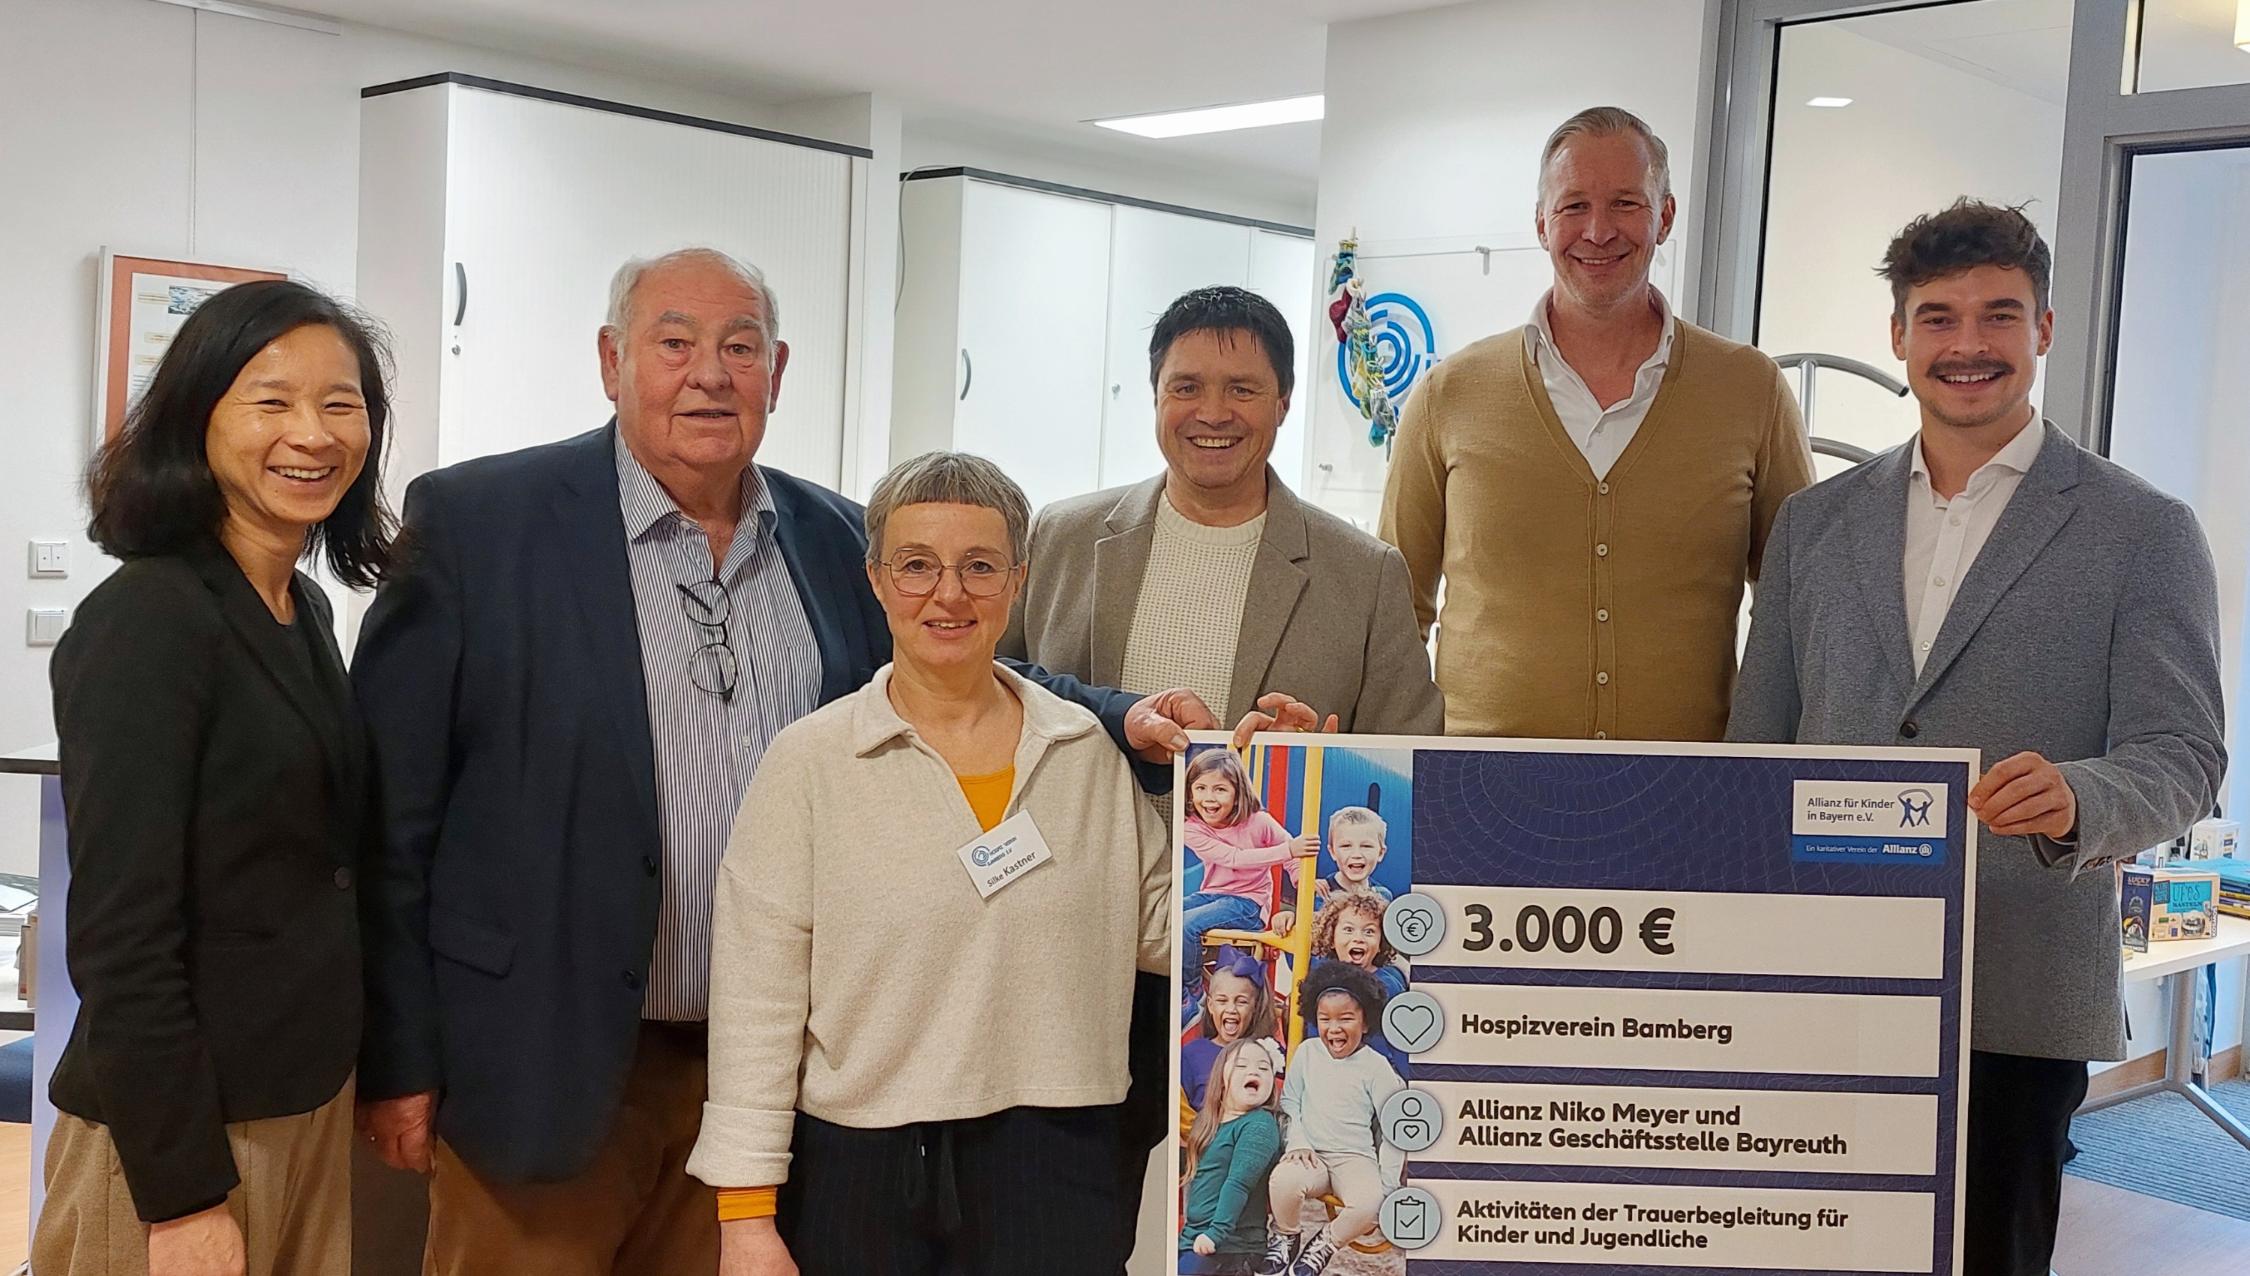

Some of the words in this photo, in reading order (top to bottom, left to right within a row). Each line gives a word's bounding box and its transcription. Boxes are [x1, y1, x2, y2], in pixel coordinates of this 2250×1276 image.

[1807, 798, 1842, 808] Allianz
[1844, 798, 1858, 808] für
[1861, 799, 1895, 809] Kinder
[1807, 811, 1817, 820] in
[1819, 811, 1854, 823] Bayern
[1856, 812, 1874, 822] e.V.
[1806, 844, 1816, 852] Ein
[1847, 845, 1867, 853] Verein
[1867, 845, 1878, 853] der
[1882, 844, 1918, 854] Allianz
[987, 874, 1004, 887] Silke
[1003, 852, 1036, 876] Kastner
[1463, 904, 1622, 954] 3.000
[1639, 908, 1675, 955] €
[1462, 1014, 1614, 1039] Hospizverein
[1623, 1018, 1732, 1044] Bamberg
[1459, 1099, 1542, 1121] Allianz
[1550, 1101, 1605, 1122] Niko
[1613, 1103, 1689, 1128] Meyer
[1696, 1105, 1740, 1125] und
[1459, 1126, 1542, 1147] Allianz
[1549, 1128, 1729, 1153] Geschäftsstelle
[1737, 1131, 1847, 1157] Bayreuth
[1457, 1200, 1576, 1221] Aktivitäten
[1582, 1203, 1618, 1222] der
[1624, 1204, 1811, 1231] Trauerbegleitung
[1816, 1207, 1848, 1227] für
[1458, 1225, 1529, 1243] Kinder
[1535, 1227, 1574, 1244] und
[1580, 1227, 1707, 1250] Jugendliche
